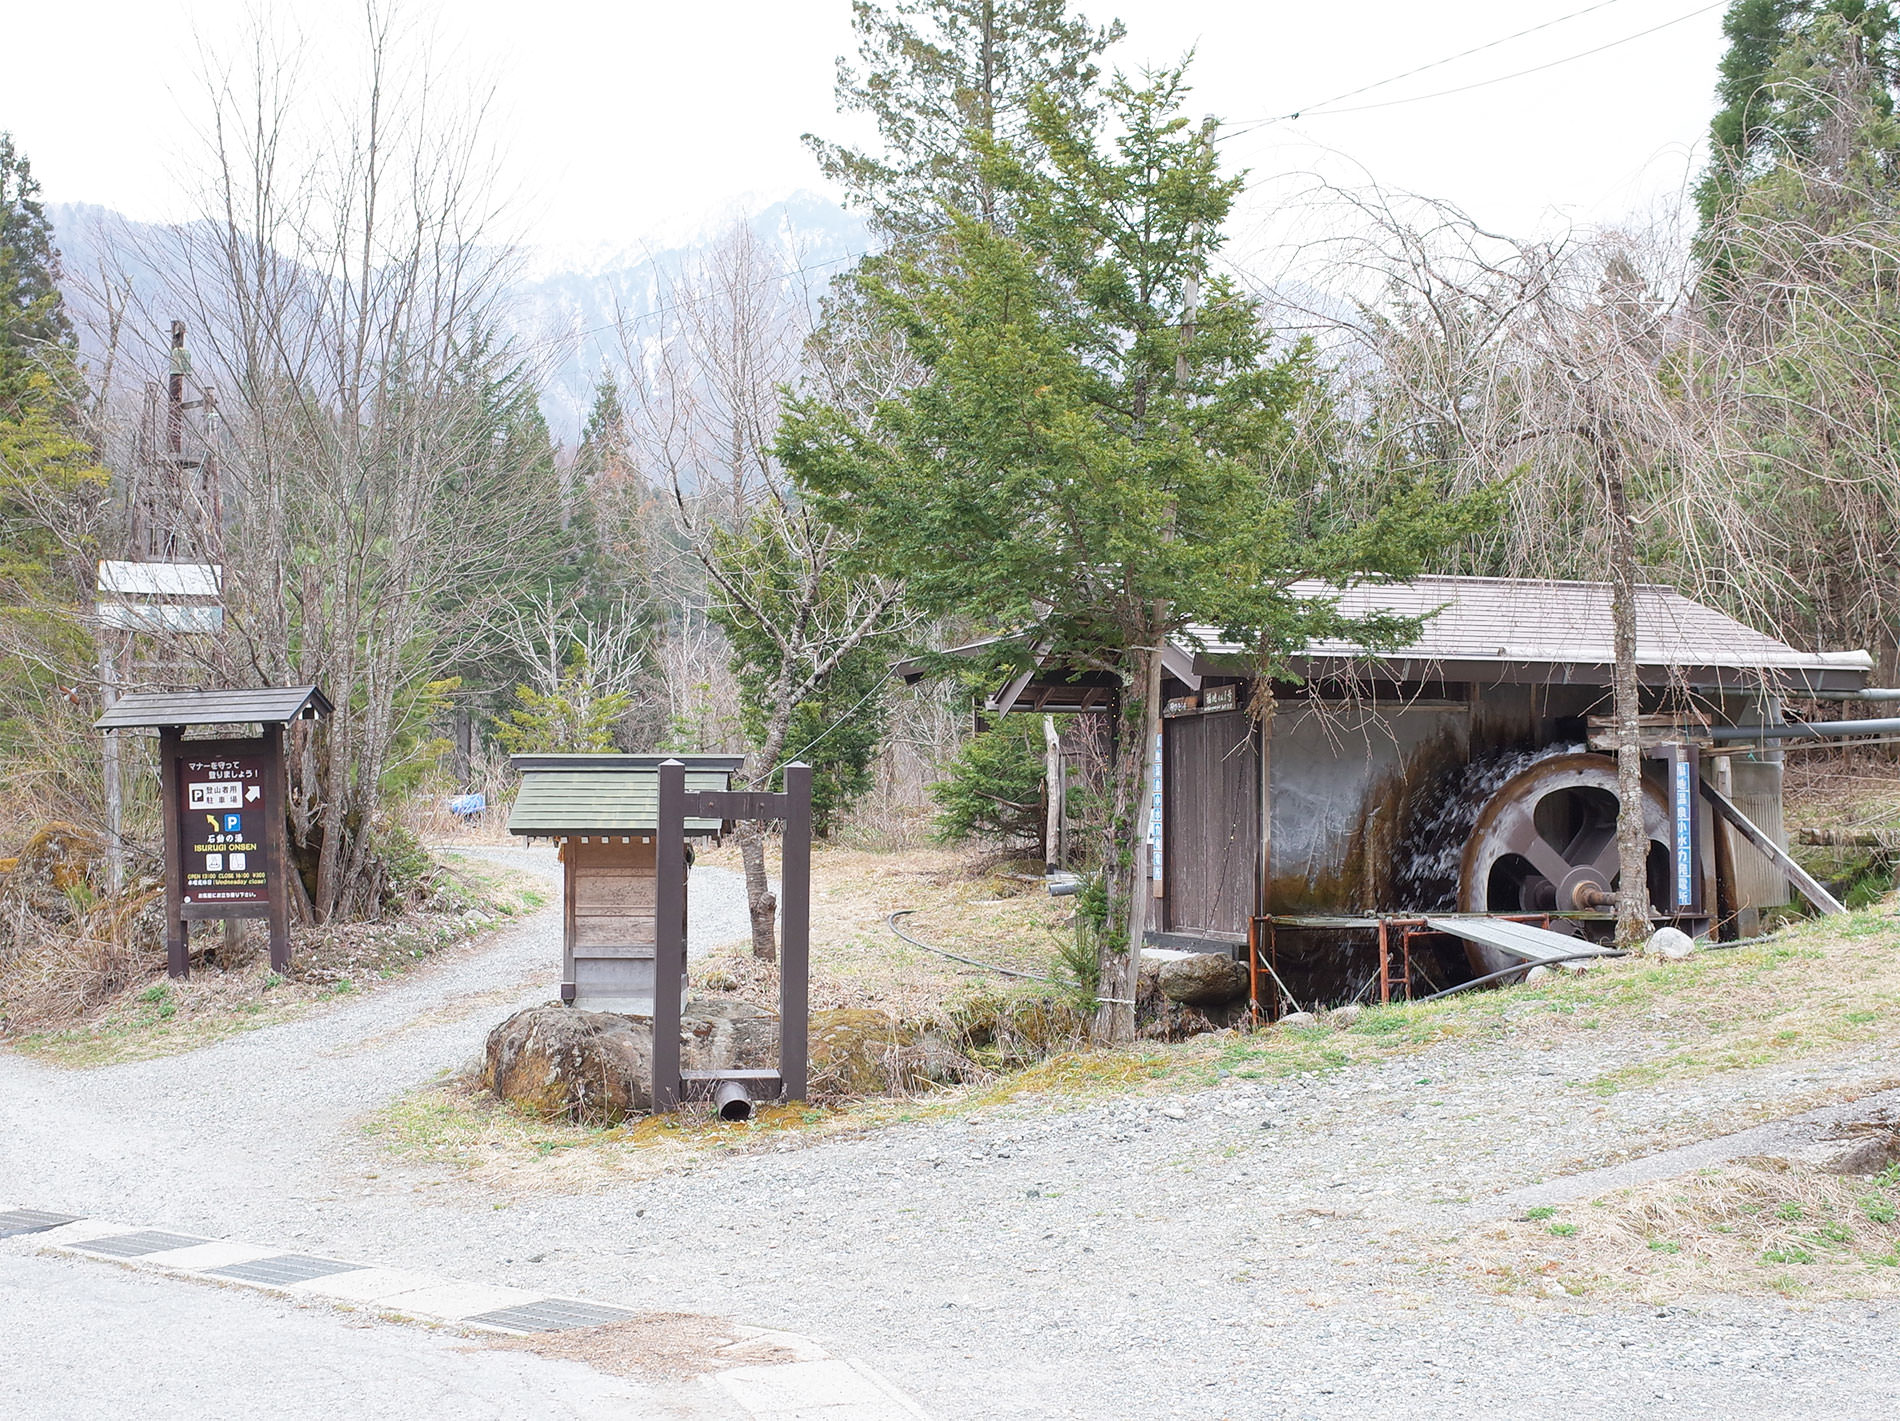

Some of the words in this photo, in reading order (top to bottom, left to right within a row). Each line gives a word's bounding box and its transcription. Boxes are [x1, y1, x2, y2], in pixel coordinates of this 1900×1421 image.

[188, 761, 240, 771] マナーを守って
[206, 785, 237, 795] 登山者用
[194, 790, 203, 802] P
[206, 796, 238, 805] 駐車場
[228, 816, 238, 830] P
[194, 844, 227, 852] ISURUGI
[228, 843, 257, 851] ONSEN
